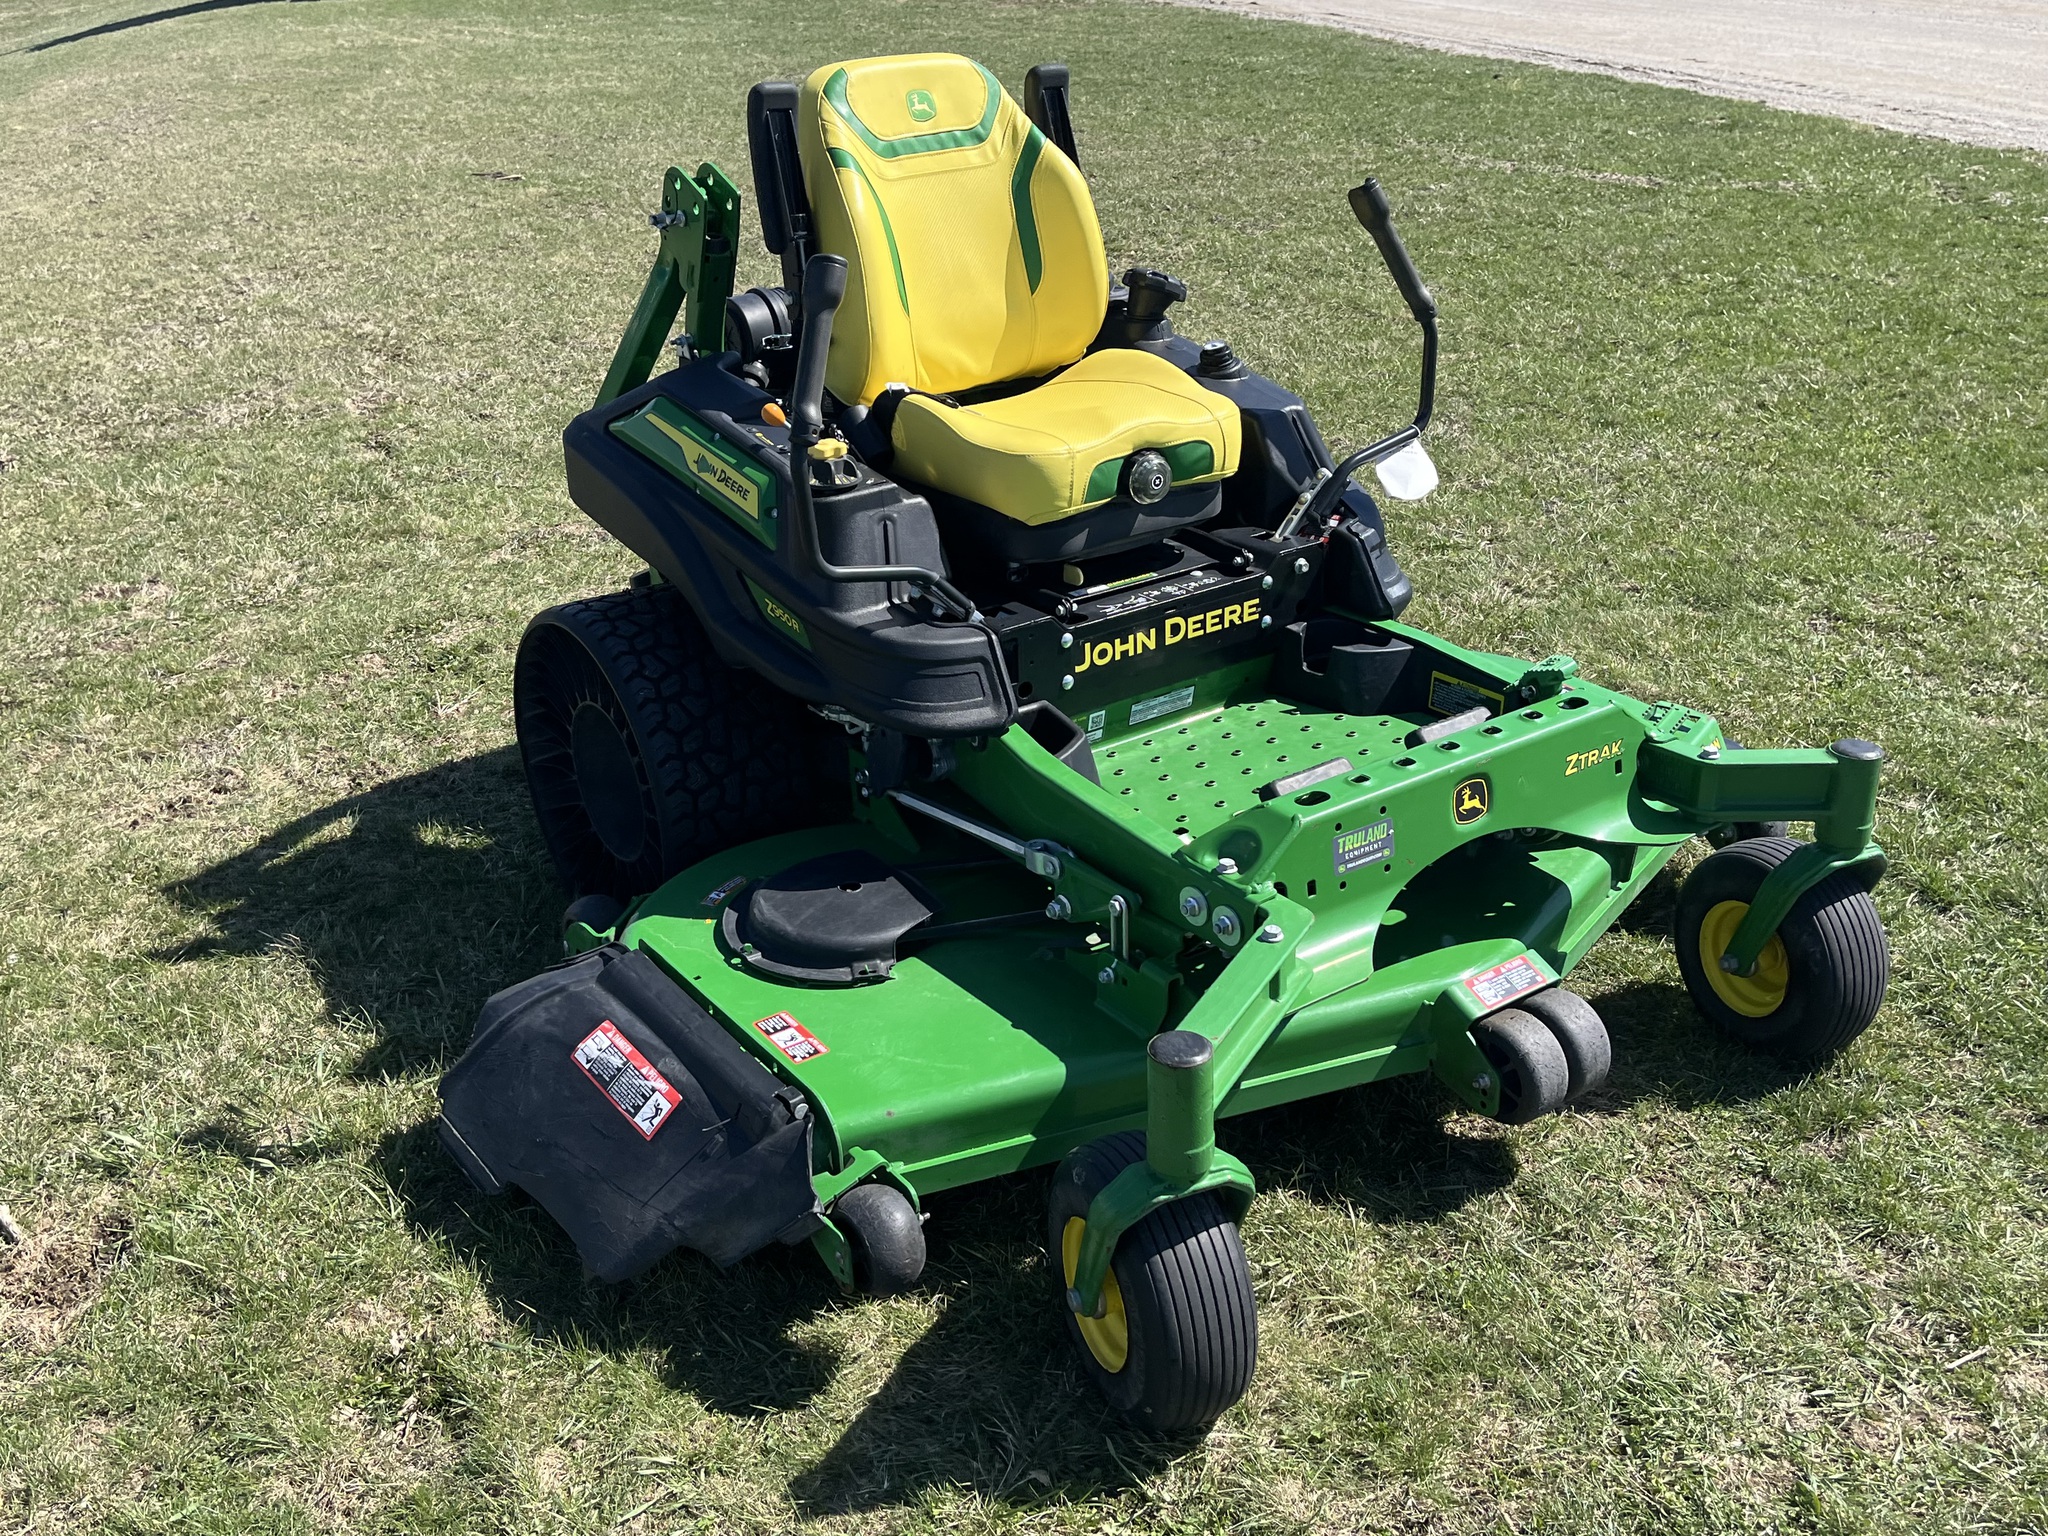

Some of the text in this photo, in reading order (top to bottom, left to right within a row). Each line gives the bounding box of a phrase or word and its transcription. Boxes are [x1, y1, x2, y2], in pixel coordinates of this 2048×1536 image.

[717, 468, 750, 501] DEERE
[764, 598, 800, 633] Z950R
[1074, 597, 1260, 673] JOHN DEERE
[1564, 738, 1624, 777] ZTRAK
[1337, 822, 1388, 854] TRULAND
[1345, 841, 1383, 860] EQUIPMENT
[612, 1034, 633, 1055] DANGER
